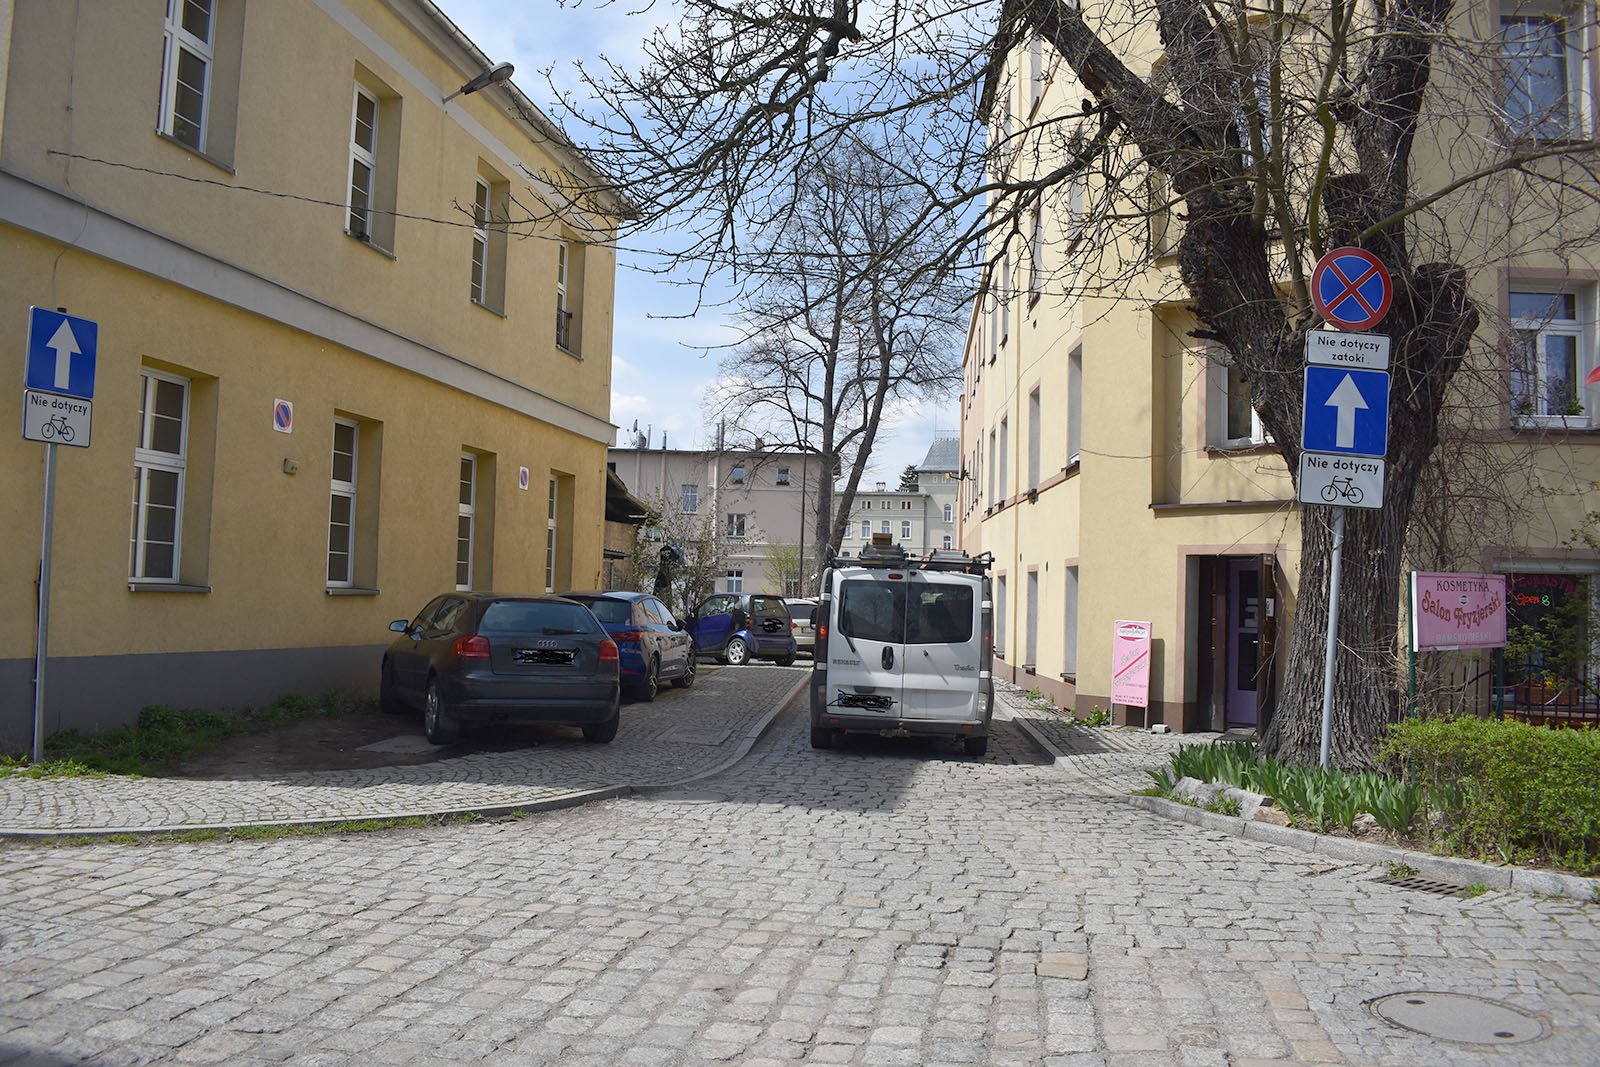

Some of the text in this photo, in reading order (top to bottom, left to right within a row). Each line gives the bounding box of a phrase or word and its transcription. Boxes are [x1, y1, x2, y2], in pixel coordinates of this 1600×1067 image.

[1317, 336, 1380, 353] Nie dotyczy
[1332, 352, 1364, 363] zatoki
[31, 395, 88, 416] Nie dotyczy
[1307, 458, 1379, 475] Nie dotyczy
[1436, 580, 1489, 592] KOSMETYKA
[1421, 590, 1501, 629] Salon Fryzjerski
